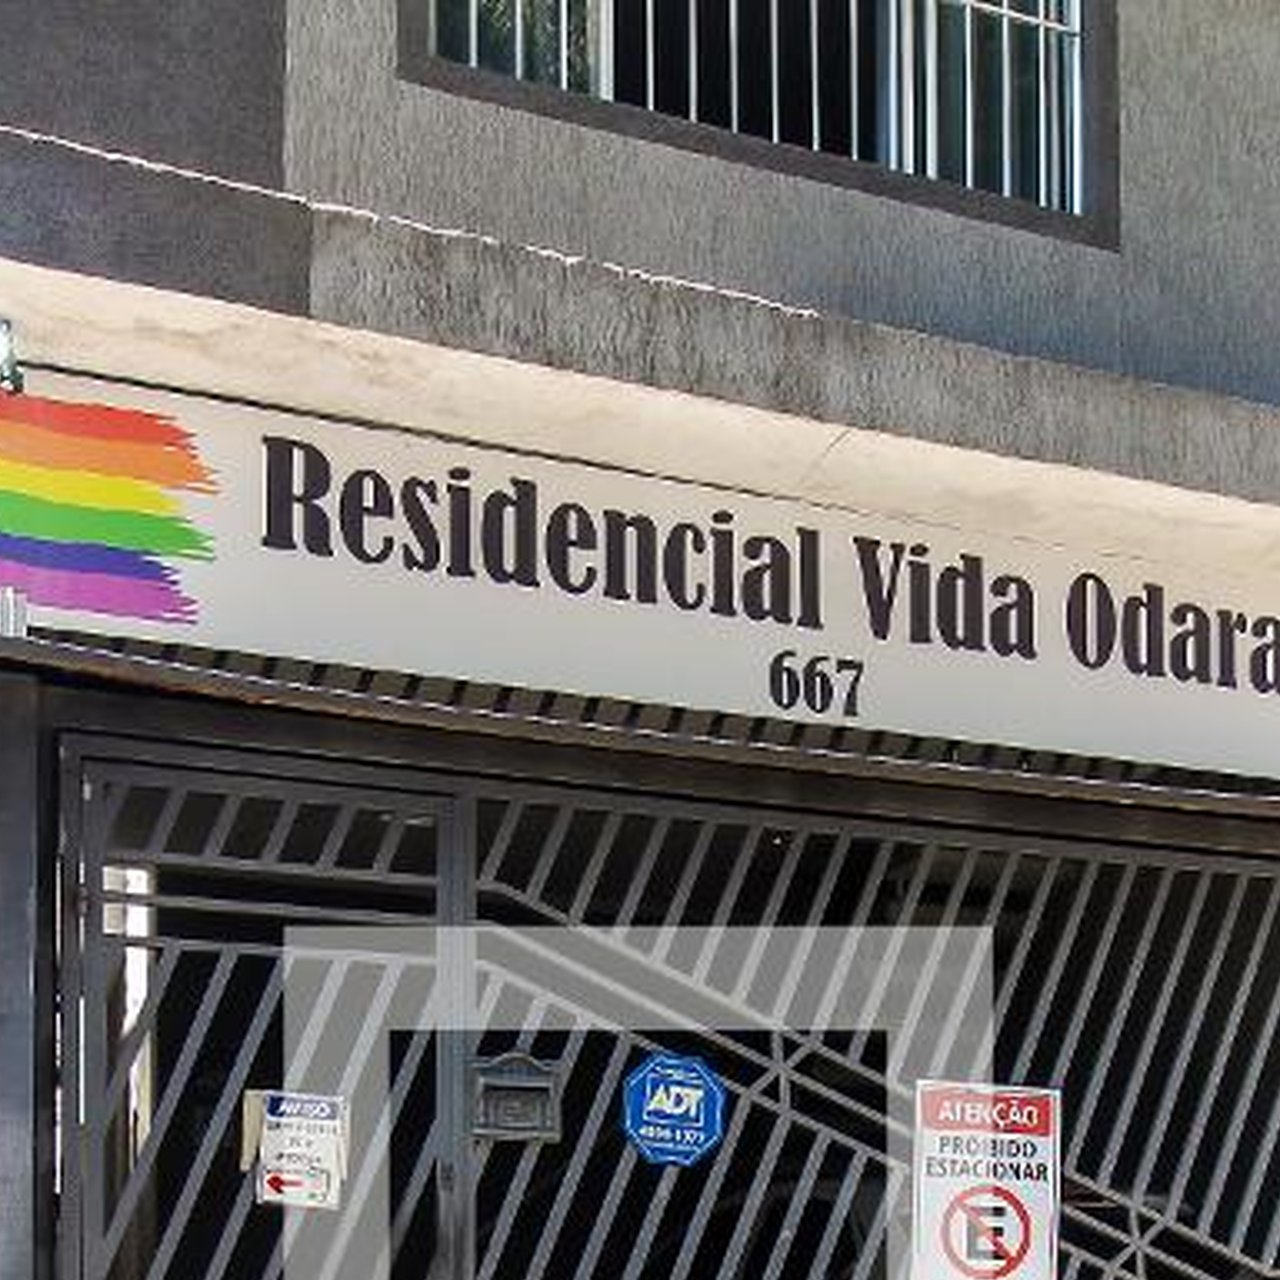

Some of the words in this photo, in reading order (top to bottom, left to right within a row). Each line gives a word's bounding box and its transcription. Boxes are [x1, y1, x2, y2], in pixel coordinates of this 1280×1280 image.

[261, 433, 825, 631] Residencial
[853, 535, 1039, 660] Vida
[769, 649, 865, 719] 667
[647, 1084, 705, 1118] ADT
[937, 1098, 1039, 1128] ATENÇÃO
[938, 1135, 1038, 1159] PROIBIDO
[925, 1158, 1049, 1182] ESTACIONAR
